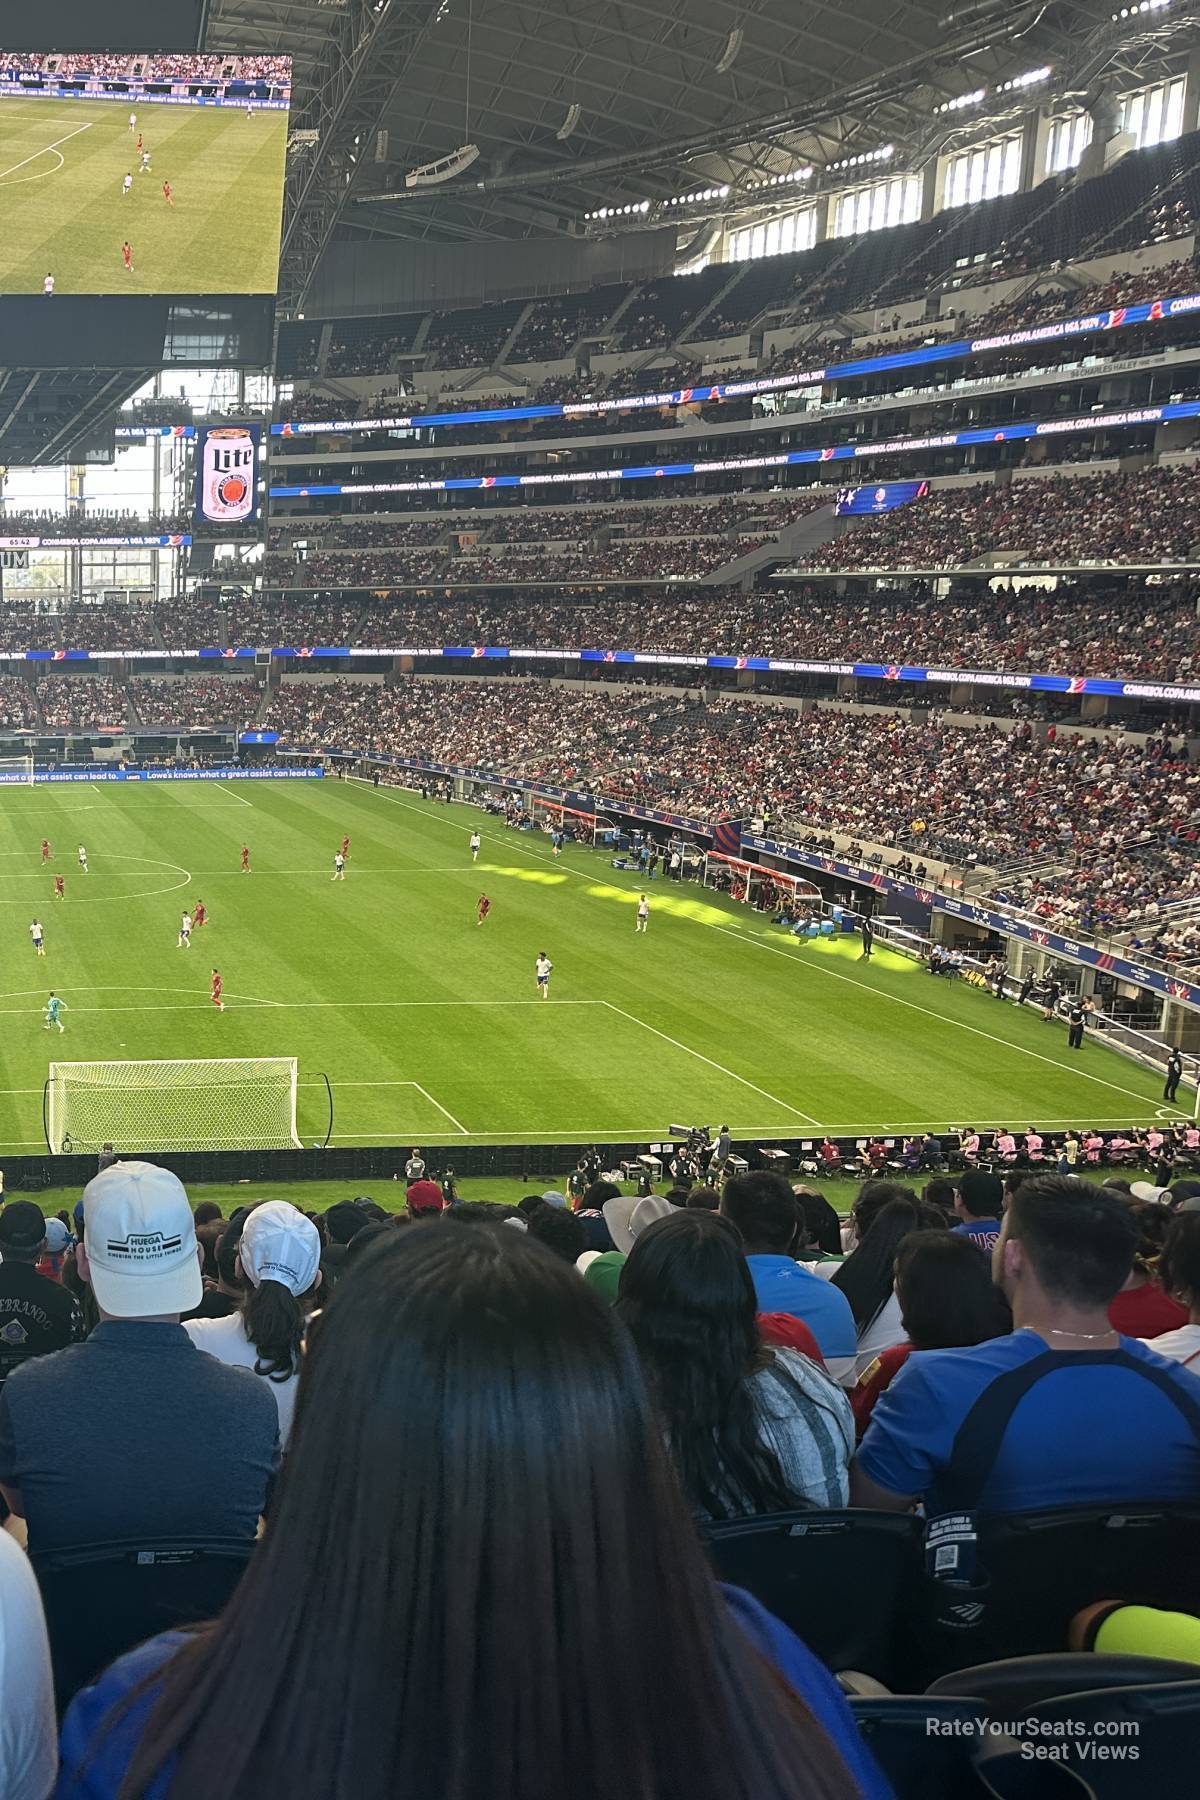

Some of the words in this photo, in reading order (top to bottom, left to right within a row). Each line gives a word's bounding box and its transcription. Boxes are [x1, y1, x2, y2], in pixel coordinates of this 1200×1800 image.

[213, 449, 252, 474] Lite
[50, 773, 72, 781] assist
[147, 771, 172, 779] Lowe's
[173, 771, 198, 779] knows
[227, 772, 248, 780] great
[130, 1236, 161, 1246] HUEGA
[131, 1245, 161, 1254] HOUSE
